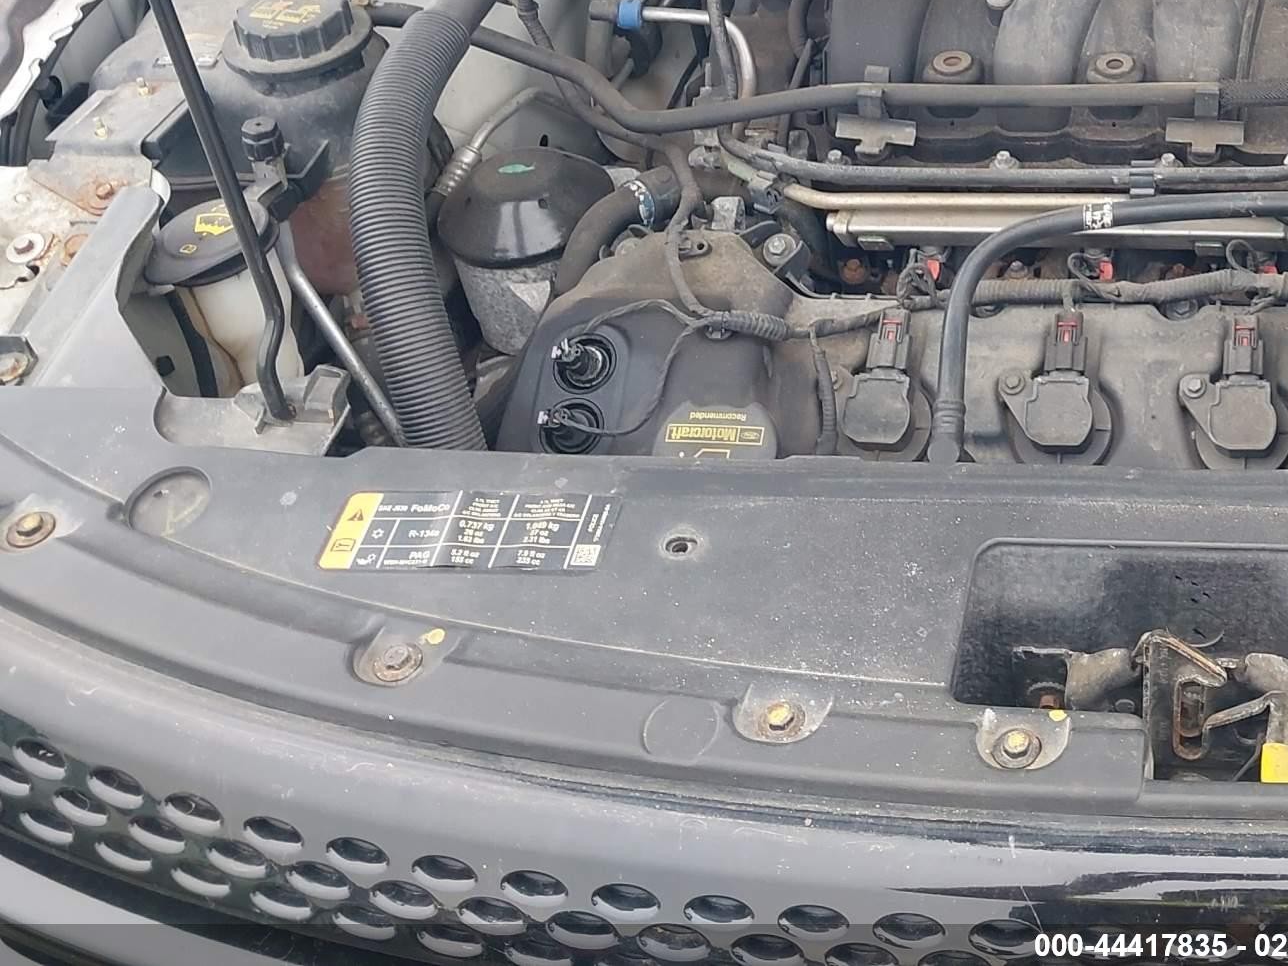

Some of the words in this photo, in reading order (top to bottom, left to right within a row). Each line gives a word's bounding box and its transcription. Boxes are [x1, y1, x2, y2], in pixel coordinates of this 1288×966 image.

[689, 411, 747, 422] Recommended
[670, 426, 737, 441] Motorcraft
[411, 503, 450, 513] FoMoCo
